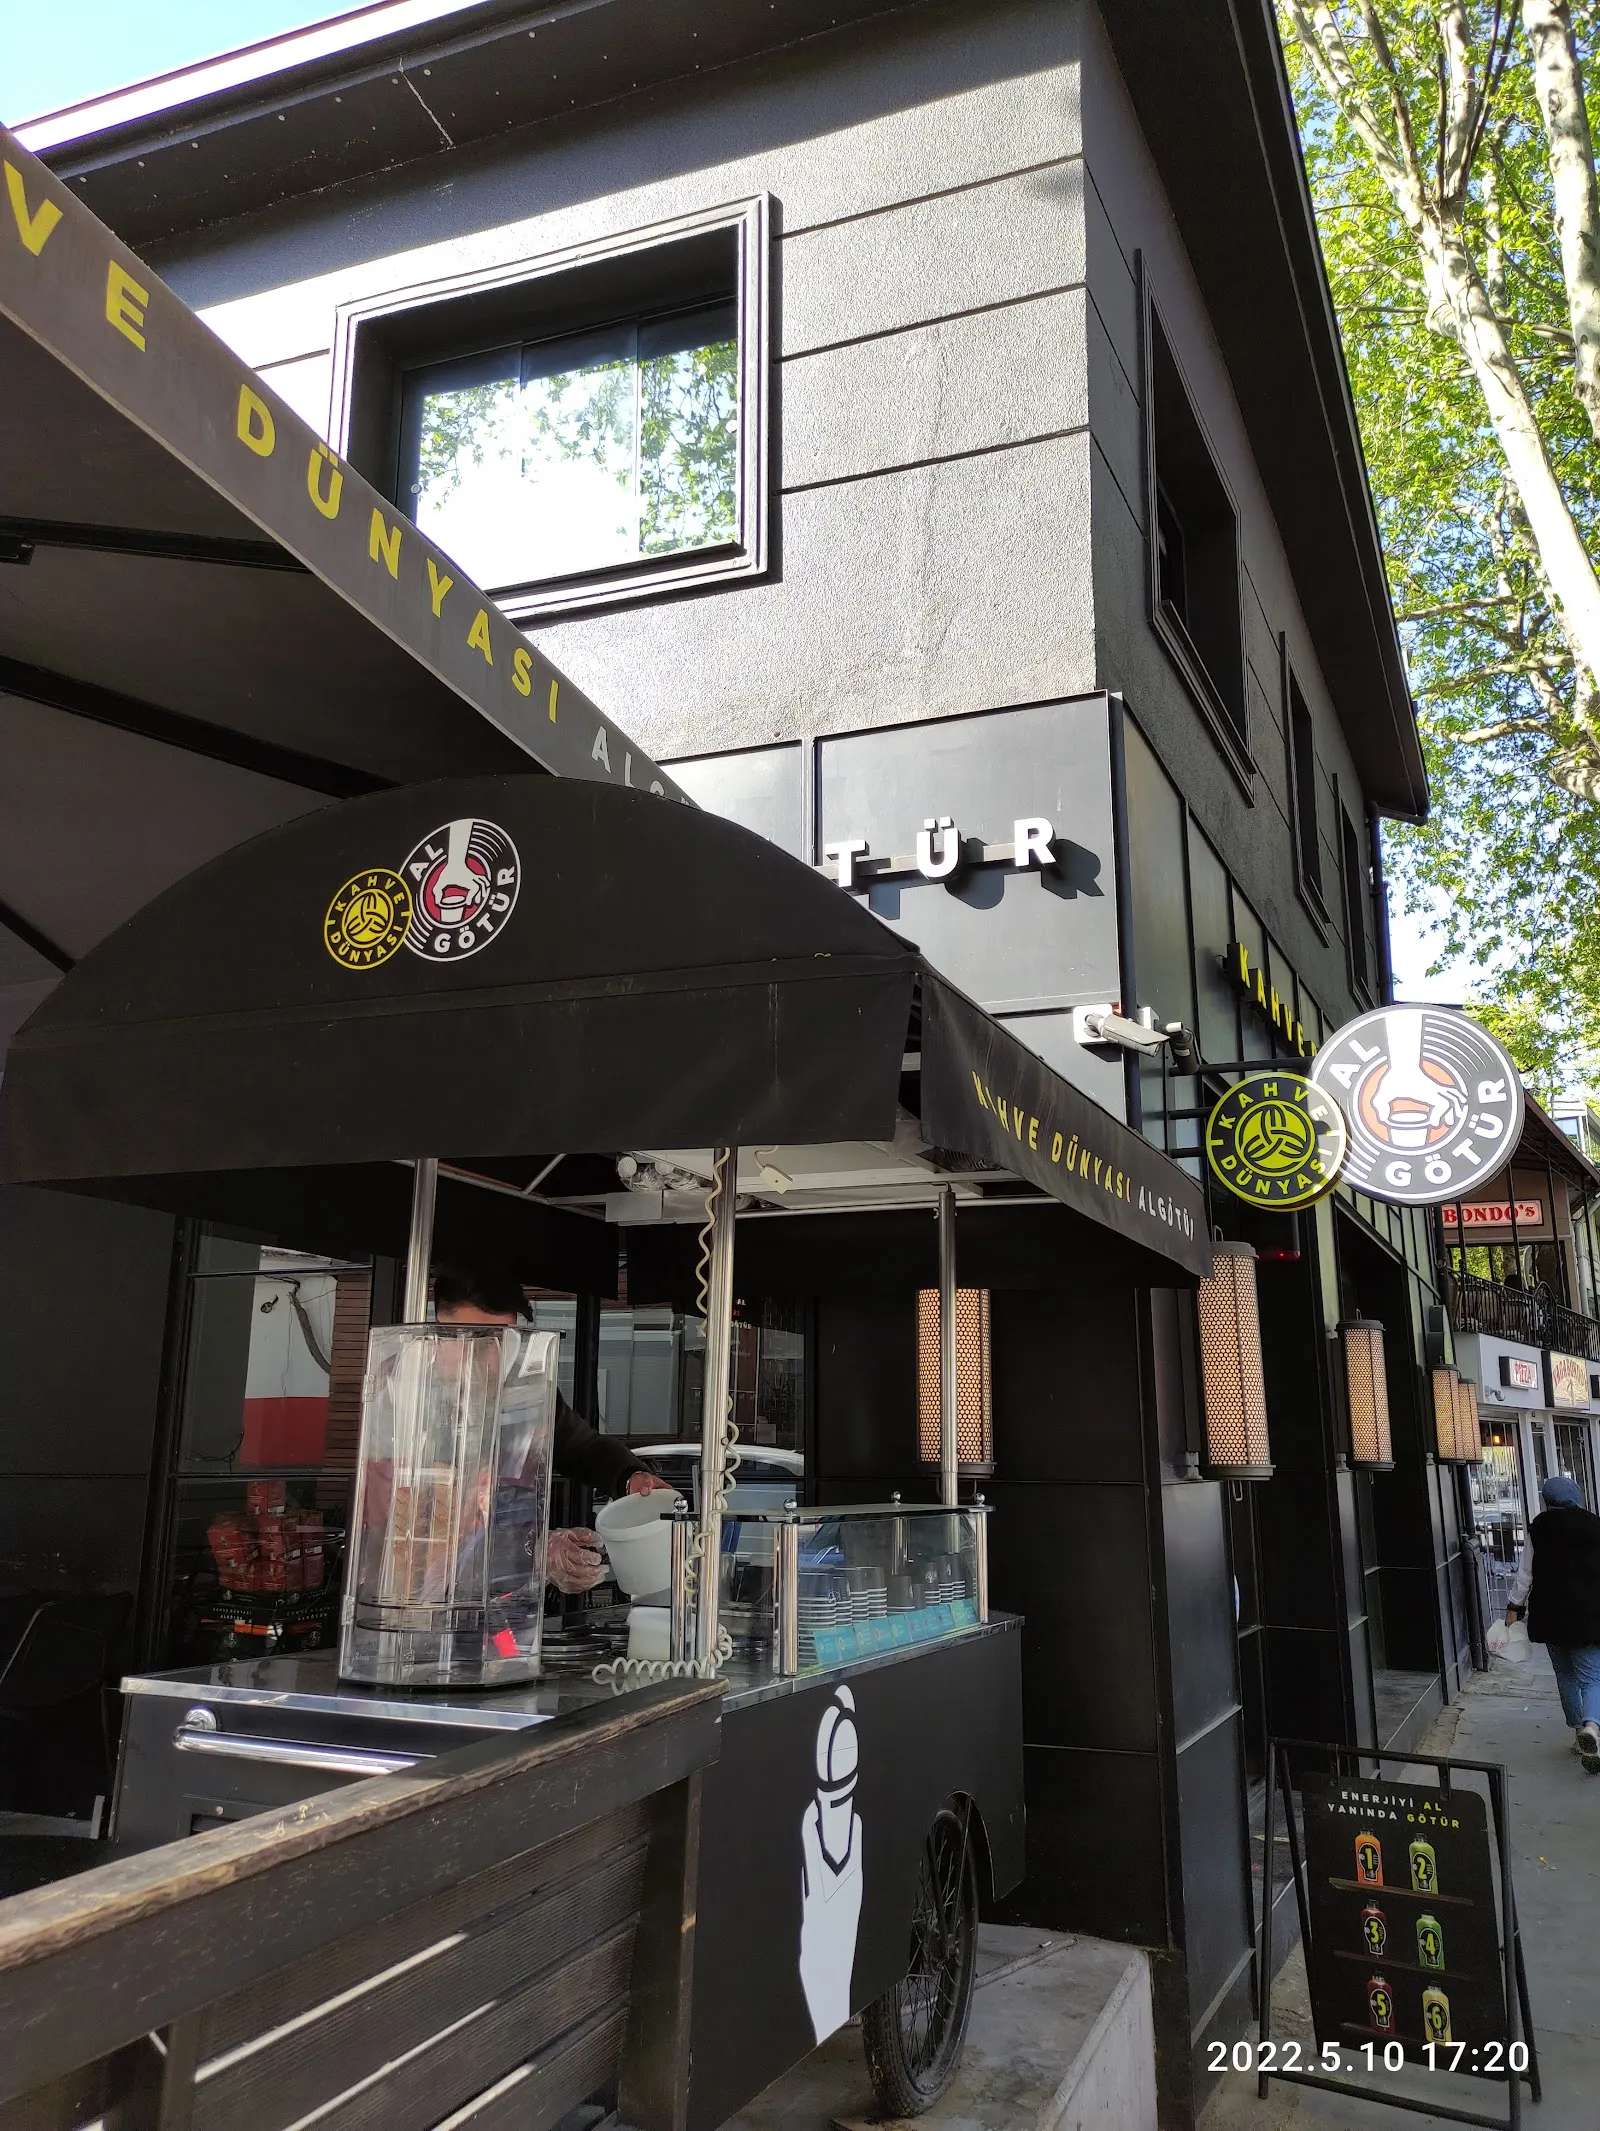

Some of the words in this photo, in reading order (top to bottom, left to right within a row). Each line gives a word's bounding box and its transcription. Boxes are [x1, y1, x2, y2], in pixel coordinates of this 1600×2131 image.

[238, 384, 558, 724] DÜNYASI
[409, 843, 444, 882] AL
[335, 875, 405, 913] KAHVE
[434, 865, 515, 953] GÖTÜR
[330, 924, 403, 963] DÜNYASI
[1239, 942, 1305, 1058] KAHVE
[1329, 1039, 1382, 1090] AL
[1218, 1082, 1329, 1130] KAHVE
[1384, 1077, 1508, 1187] GÖTÜR
[1051, 1131, 1132, 1203] DÜNYASI
[1219, 1148, 1333, 1196] DÜNYASI
[1327, 1803, 1398, 1820] YANINDA
[1406, 1813, 1460, 1829] GÖTÜR
[1341, 1790, 1414, 1808] ENERJİYİ
[1423, 1801, 1442, 1812] AL
[1364, 1847, 1373, 1870] 1
[1417, 1857, 1427, 1879] 2
[1369, 1921, 1379, 1944] 3
[1425, 1933, 1436, 1956] 4
[1376, 1993, 1387, 2016] 5
[1431, 2006, 1441, 2030] 6
